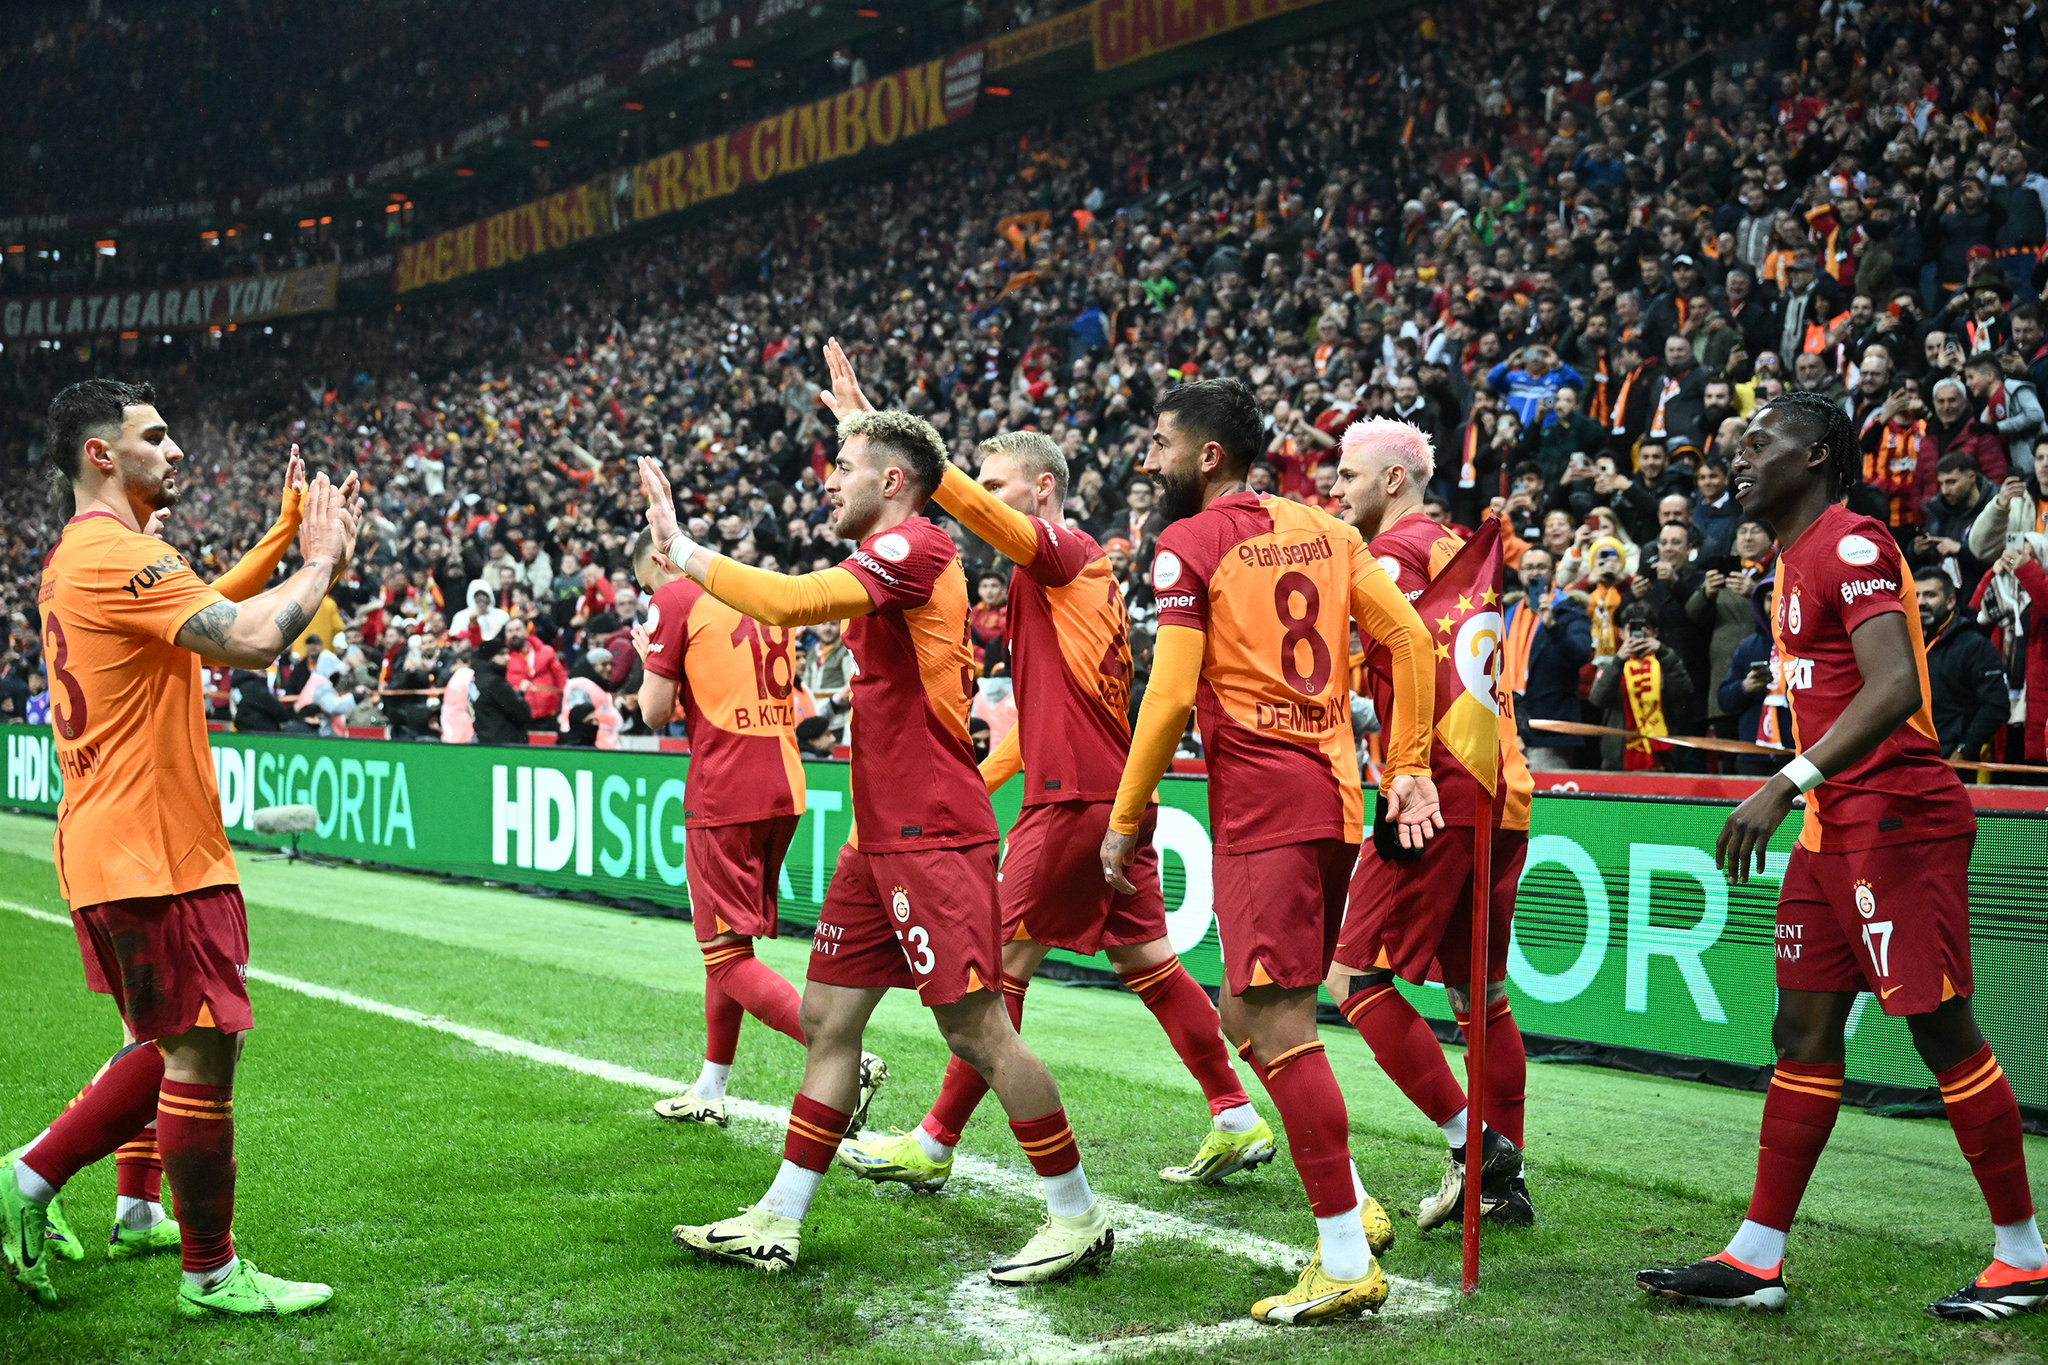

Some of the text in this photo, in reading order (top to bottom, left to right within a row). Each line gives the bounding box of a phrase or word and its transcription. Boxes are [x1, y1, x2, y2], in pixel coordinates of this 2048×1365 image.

[4, 286, 219, 337] GALATASARAY
[1841, 578, 1897, 605] Bilyoner
[730, 613, 793, 700] 18
[1274, 571, 1332, 697] 8
[46, 610, 88, 741] 3
[735, 708, 757, 730] B.
[8, 734, 49, 803] HDI
[492, 764, 594, 877] HDI
[1861, 920, 1894, 977] 17
